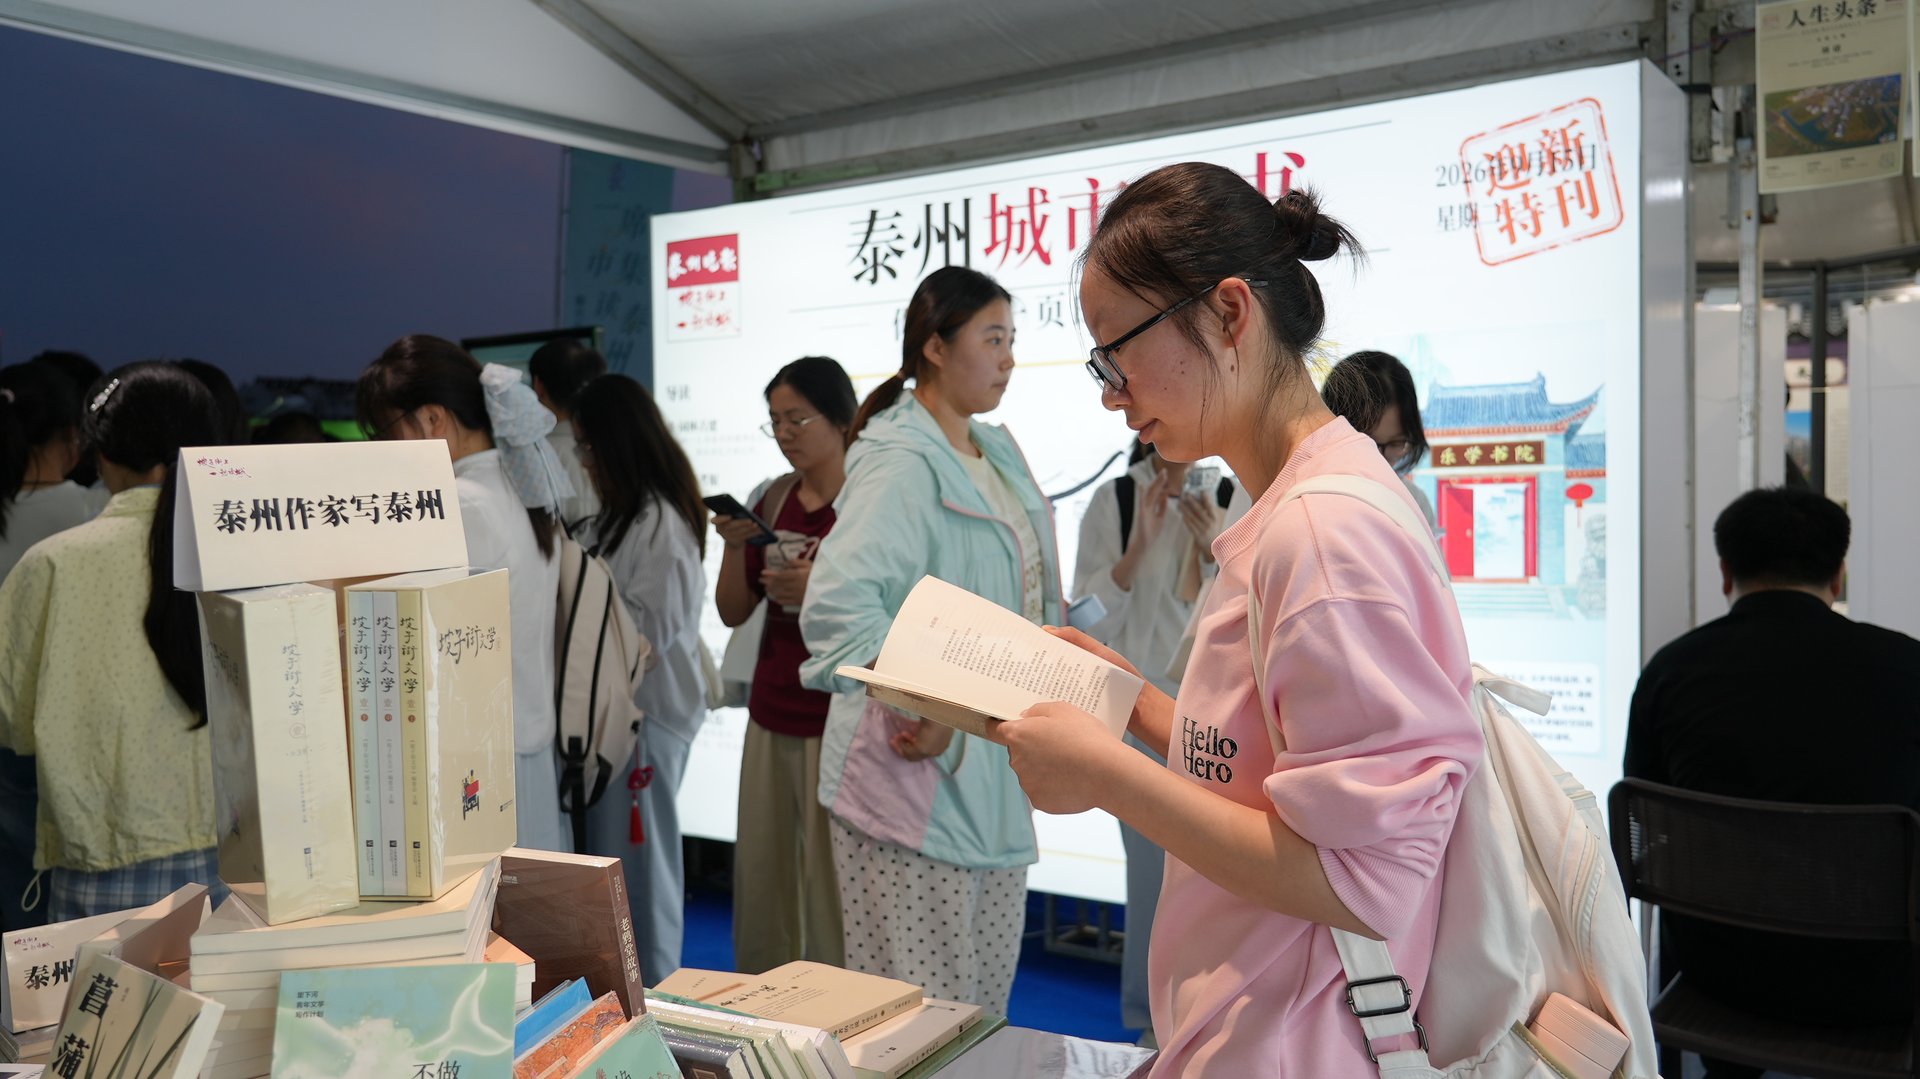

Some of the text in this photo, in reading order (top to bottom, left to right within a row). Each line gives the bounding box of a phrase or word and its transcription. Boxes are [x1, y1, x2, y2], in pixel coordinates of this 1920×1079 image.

[1788, 0, 1877, 30] 人生头条
[1498, 170, 1601, 245] 特刊
[1439, 443, 1536, 466] 乐学书院
[212, 488, 446, 534] 泰州作家写泰州
[1182, 715, 1238, 759] Hello
[1182, 743, 1232, 784] Hero
[411, 1060, 462, 1079] 不做
